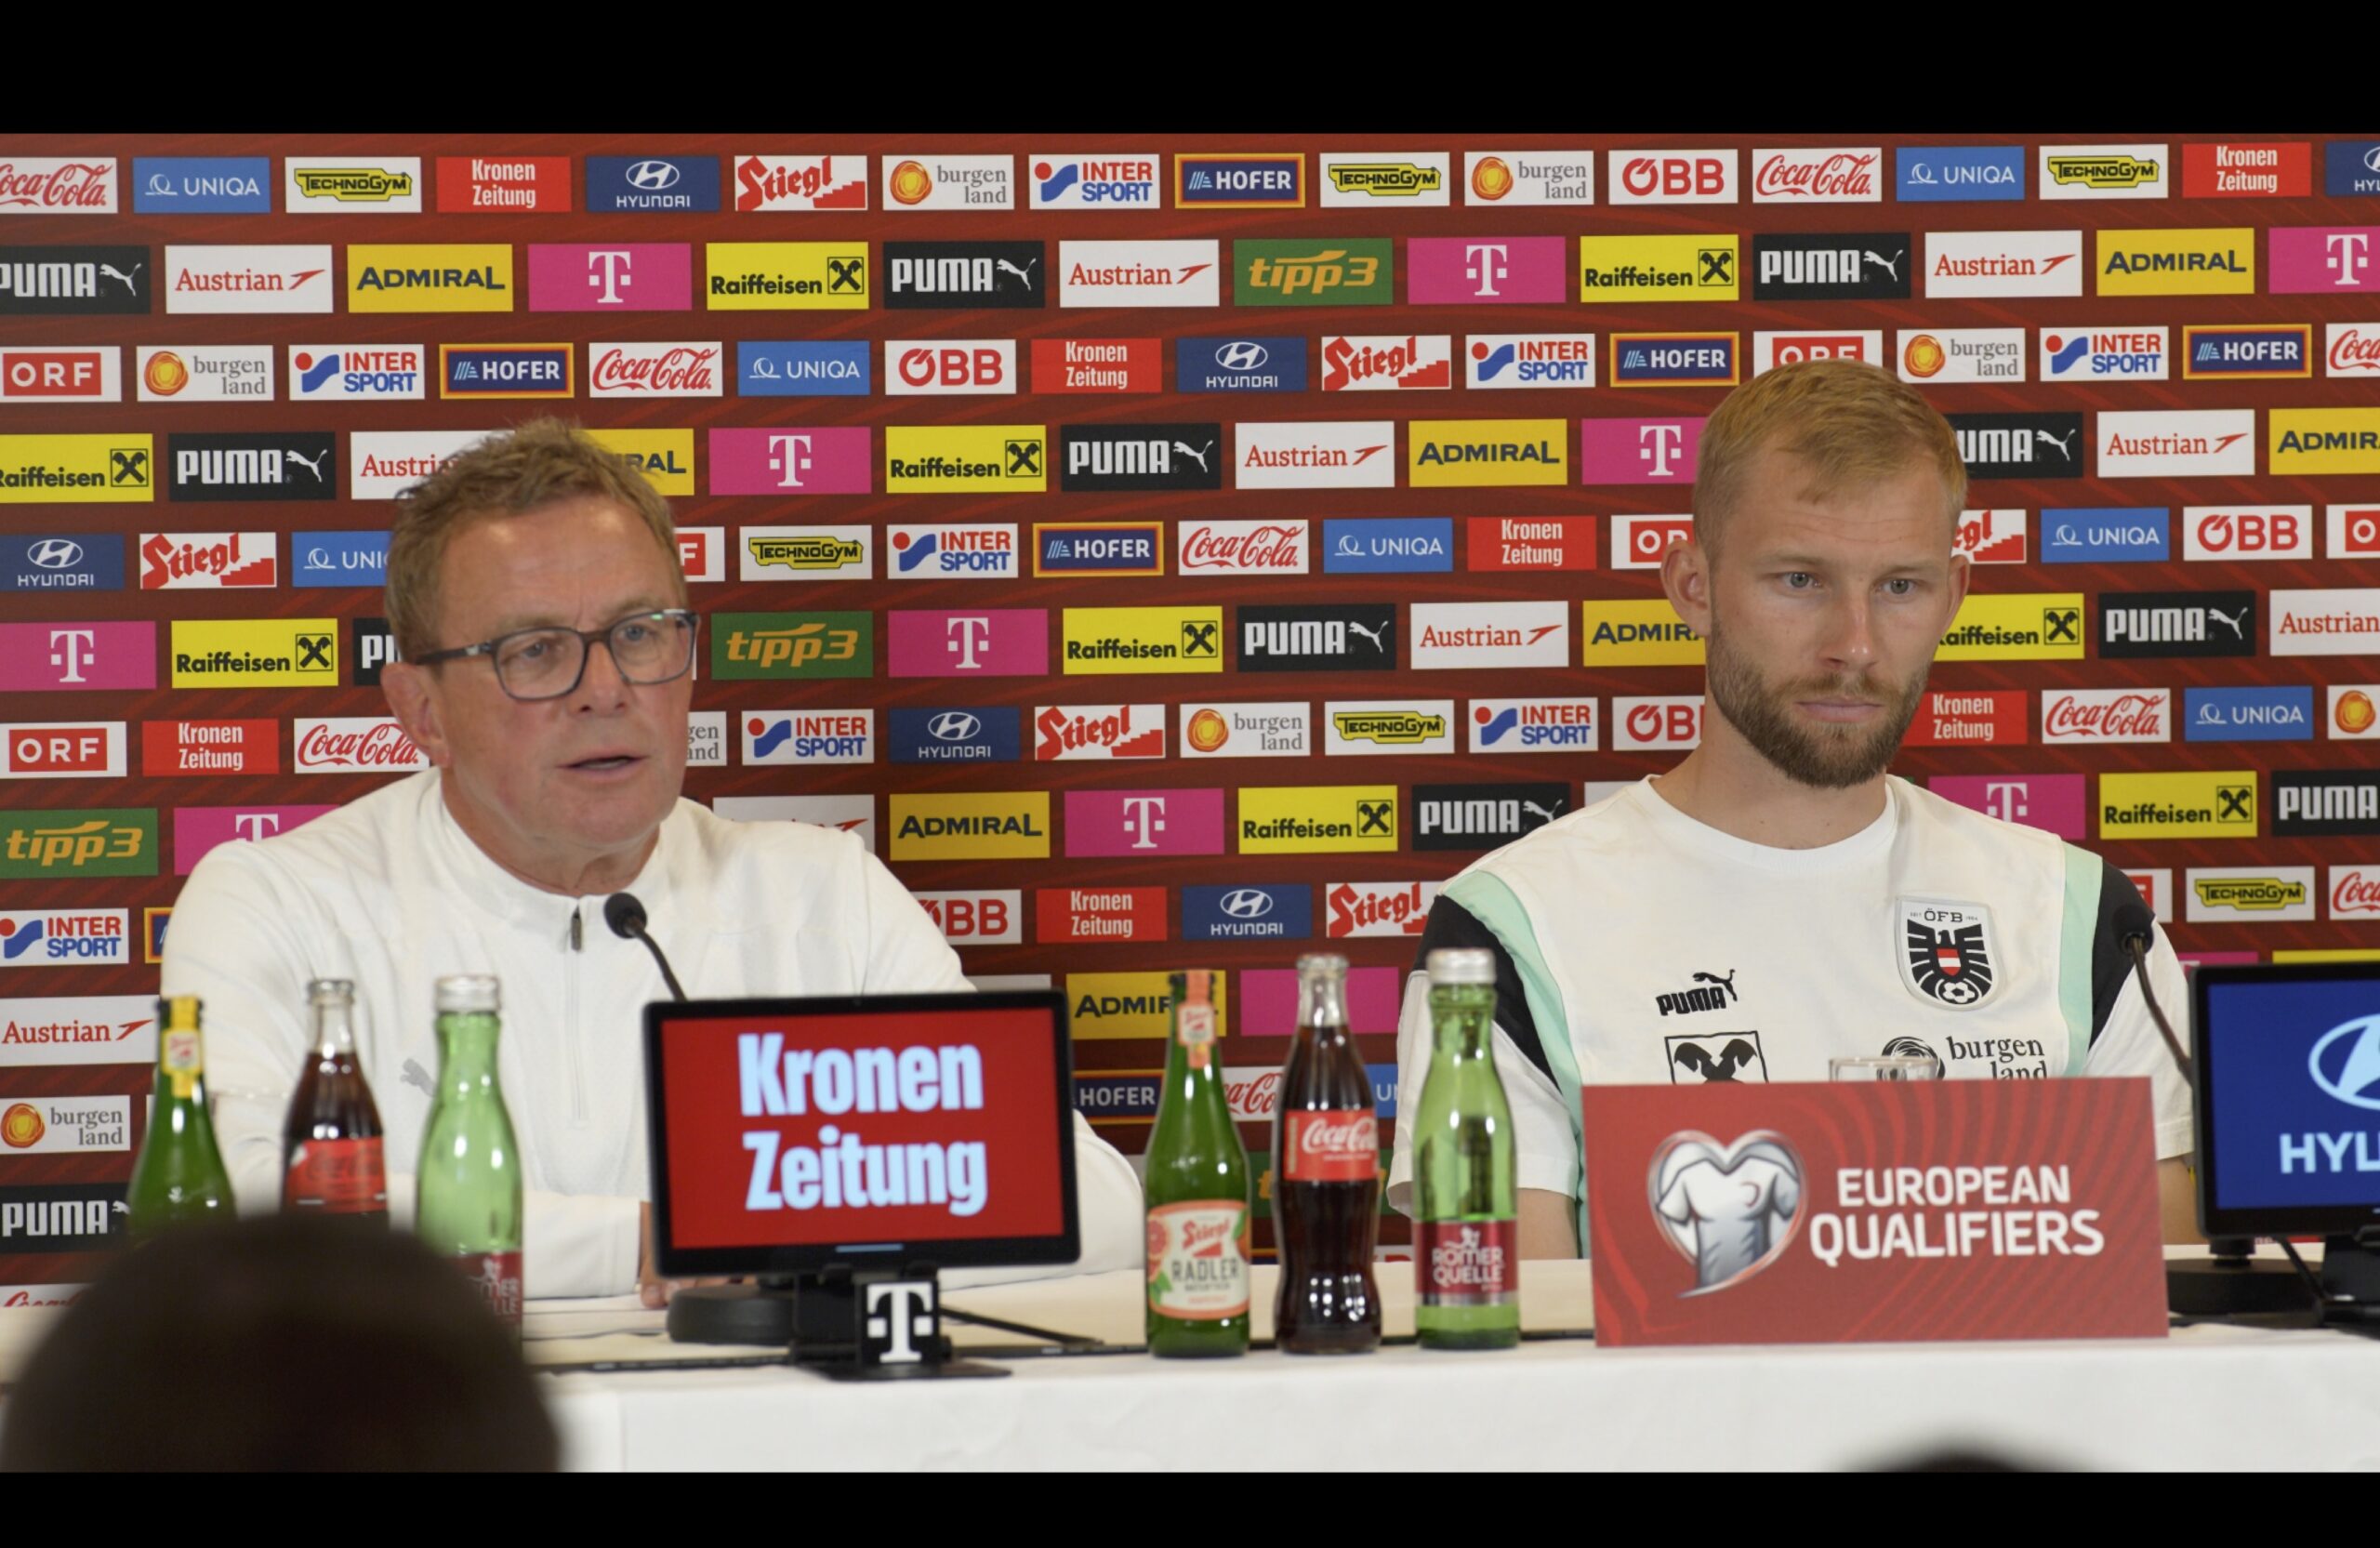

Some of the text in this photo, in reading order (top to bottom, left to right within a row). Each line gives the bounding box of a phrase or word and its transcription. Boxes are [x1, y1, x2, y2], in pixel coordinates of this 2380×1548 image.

[2217, 146, 2277, 166] Kronen
[472, 160, 535, 180] Kronen
[937, 165, 1006, 188] burgen
[1083, 163, 1152, 180] INTER
[1217, 171, 1290, 190] HOFER
[1518, 161, 1586, 183] burgen
[1622, 158, 1724, 196] ÖBB
[1756, 154, 1877, 195] Coca-Cola
[1945, 166, 2015, 184] UNIQA
[2217, 170, 2277, 192] Zeitung
[184, 178, 260, 195] UNIQA
[737, 156, 833, 210] Stiegl
[1082, 182, 1152, 201] SPORT
[1545, 181, 1586, 198] land
[473, 184, 536, 208] Zeitung
[616, 195, 690, 207] HYUNDAI
[965, 186, 1006, 203] land
[1250, 250, 1378, 294] tipp3
[1761, 250, 1859, 283] PUMA
[1935, 254, 2036, 276] Austrian
[2106, 250, 2246, 274] ADMIRAL
[176, 269, 283, 291] Austrian
[357, 267, 505, 290] ADMIRAL
[711, 274, 822, 294] Raiffeisen
[892, 258, 992, 292] PUMA
[1069, 263, 1172, 285] Austrian
[1586, 267, 1692, 286] Raiffeisen
[1066, 341, 1127, 362] Kronen
[1520, 341, 1587, 360] INTER
[1950, 338, 2018, 360] burgen
[2094, 334, 2161, 352] INTER
[2225, 341, 2297, 360] HOFER
[193, 355, 265, 378] burgen
[345, 352, 416, 371] INTER
[592, 349, 718, 390] Coca-Cola
[787, 361, 860, 378] UNIQA
[899, 349, 1002, 387] ÖBB
[1324, 337, 1417, 391] Stiegl
[1651, 350, 1726, 367] HOFER
[1977, 358, 2017, 376] land
[2093, 354, 2161, 373] SPORT
[12, 363, 93, 387] ORF
[483, 362, 559, 379] HOFER
[1066, 366, 1127, 389] Zeitung
[1518, 362, 1588, 380] SPORT
[222, 377, 266, 394] land
[344, 373, 416, 391] SPORT
[1207, 377, 1277, 388] HYUNDAI
[1956, 429, 2032, 463] UMA
[2107, 433, 2208, 456] Austrian
[2277, 429, 2380, 454] ADMIR
[1069, 441, 1170, 474] PUMA
[1245, 445, 1347, 467] Austrian
[1418, 442, 1560, 465] ADMIRAL
[178, 450, 282, 483] PUMA
[892, 457, 999, 477] Raiffeisen
[1502, 520, 1562, 539] Kronen
[2089, 527, 2160, 545] UNIQA
[2198, 515, 2298, 552] ÖBB
[942, 532, 1010, 550] INTER
[1075, 539, 1149, 558] HOFER
[1182, 526, 1303, 568] Coca-Cola
[1372, 537, 1443, 555] UNIQA
[143, 533, 240, 589] Stiegl
[341, 549, 390, 570] UNI
[941, 551, 1011, 571] SPORT
[1502, 544, 1562, 566] Zeitung
[18, 574, 94, 586] HYUNDAI
[1592, 622, 1704, 645] ADMIR
[2107, 608, 2204, 642] PUMA
[2279, 613, 2380, 635] Austrian
[727, 624, 858, 668] tipp3
[1246, 621, 1344, 655] PUMA
[1421, 625, 1522, 647] Austrian
[1938, 626, 2040, 646] aiffeisen
[1068, 639, 1176, 659] Raiffeisen
[177, 652, 290, 672] Raiffeisen
[1523, 706, 1590, 724] INTER
[1934, 695, 1993, 714] Kronen
[2045, 695, 2164, 736] Coca-Cola
[2233, 706, 2304, 724] UNIQA
[178, 723, 242, 744] Kronen
[797, 717, 866, 736] INTER
[1037, 706, 1130, 760] Stiegl
[1235, 713, 1302, 734] burgen
[1626, 705, 1704, 742] ÖB
[1934, 719, 1993, 741] Zeitung
[1262, 733, 1302, 750] land
[1522, 725, 1590, 745] SPORT
[18, 738, 99, 762] ORF
[796, 737, 866, 757] SPORT
[919, 746, 990, 758] HYUNDAI
[179, 748, 243, 771] Zeitung
[2280, 786, 2377, 819] PUMA
[1421, 800, 1519, 834] PUMA
[2105, 804, 2211, 824] Raiffeisen
[898, 814, 1042, 839] ADMIRAL
[1244, 818, 1352, 839] Raiffeisen
[7, 821, 142, 866] tipp3
[1071, 891, 1131, 910] Kronen
[1329, 883, 1421, 937] Stiegl
[1072, 915, 1132, 937] Zeitung
[1924, 907, 1964, 923] ÖFB
[48, 917, 121, 936] INTER
[1211, 923, 1283, 935] HYUNDAI
[47, 937, 121, 958] SPORT
[1076, 995, 1171, 1018] ADMIR
[1656, 986, 1726, 1016] PUMA
[2, 1020, 111, 1044] Austrian
[1946, 1037, 2044, 1064] burgen
[739, 1034, 983, 1116] Kronen
[1990, 1060, 2047, 1079] land
[1080, 1087, 1155, 1105] HOFER
[51, 1107, 122, 1129] burgen
[79, 1127, 123, 1145] land
[743, 1126, 986, 1215] Zeitung
[1838, 1166, 2069, 1207] EUROPEAN
[3, 1200, 107, 1237] PUMA
[1810, 1210, 2104, 1266] QUALIFIERS
[1171, 1258, 1238, 1282] RADLER
[1433, 1264, 1504, 1288] QUELLE
